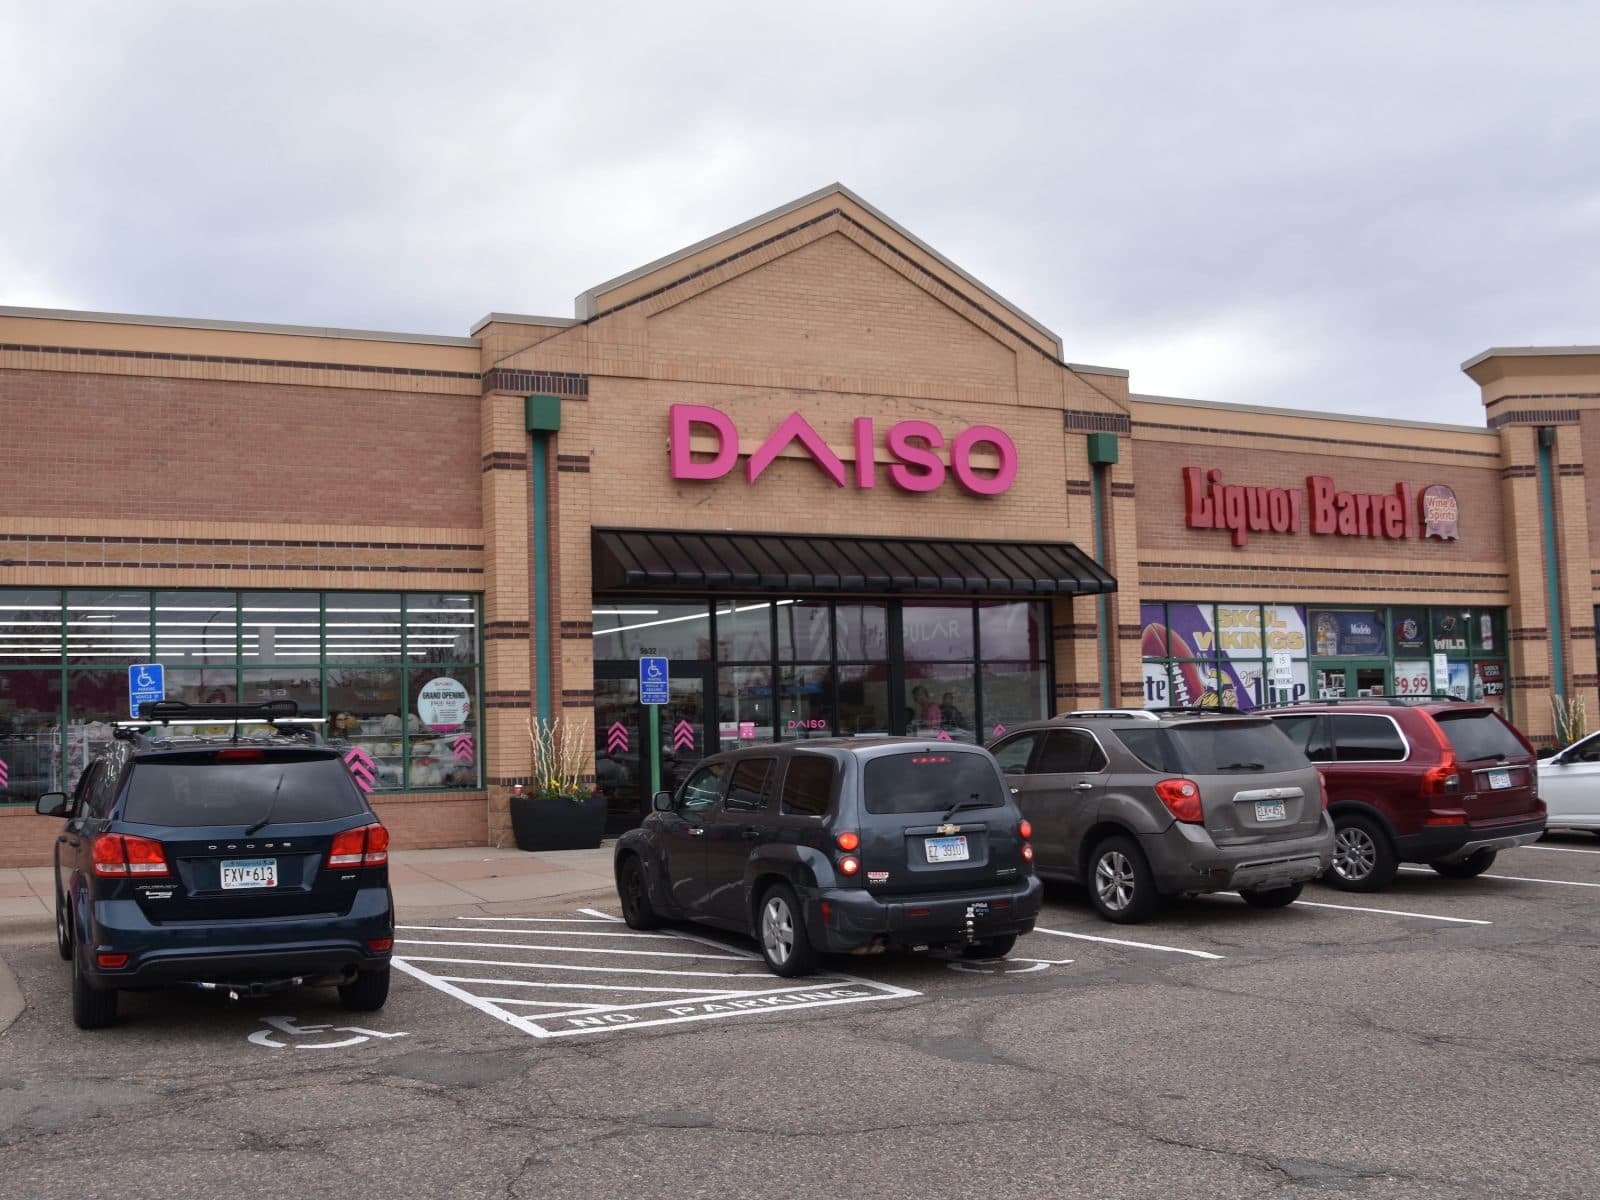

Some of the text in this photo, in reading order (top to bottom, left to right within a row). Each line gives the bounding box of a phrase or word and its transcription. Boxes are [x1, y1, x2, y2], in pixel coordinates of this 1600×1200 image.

[669, 403, 1018, 495] DAISO
[1182, 467, 1412, 546] Liquor Barrel
[1427, 495, 1448, 508] Wine
[1428, 509, 1457, 522] Spirits
[1216, 608, 1287, 628] SKOL
[1350, 623, 1371, 635] Modelo
[1434, 639, 1466, 650] WILD
[1394, 677, 1428, 694] $9.99
[423, 691, 466, 700] GRAND OPENING
[787, 720, 826, 729] DAISO
[208, 842, 292, 850] DODGE
[223, 866, 274, 882] FXV 613
[666, 989, 871, 1016] PARKING
[567, 1013, 640, 1027] NO
